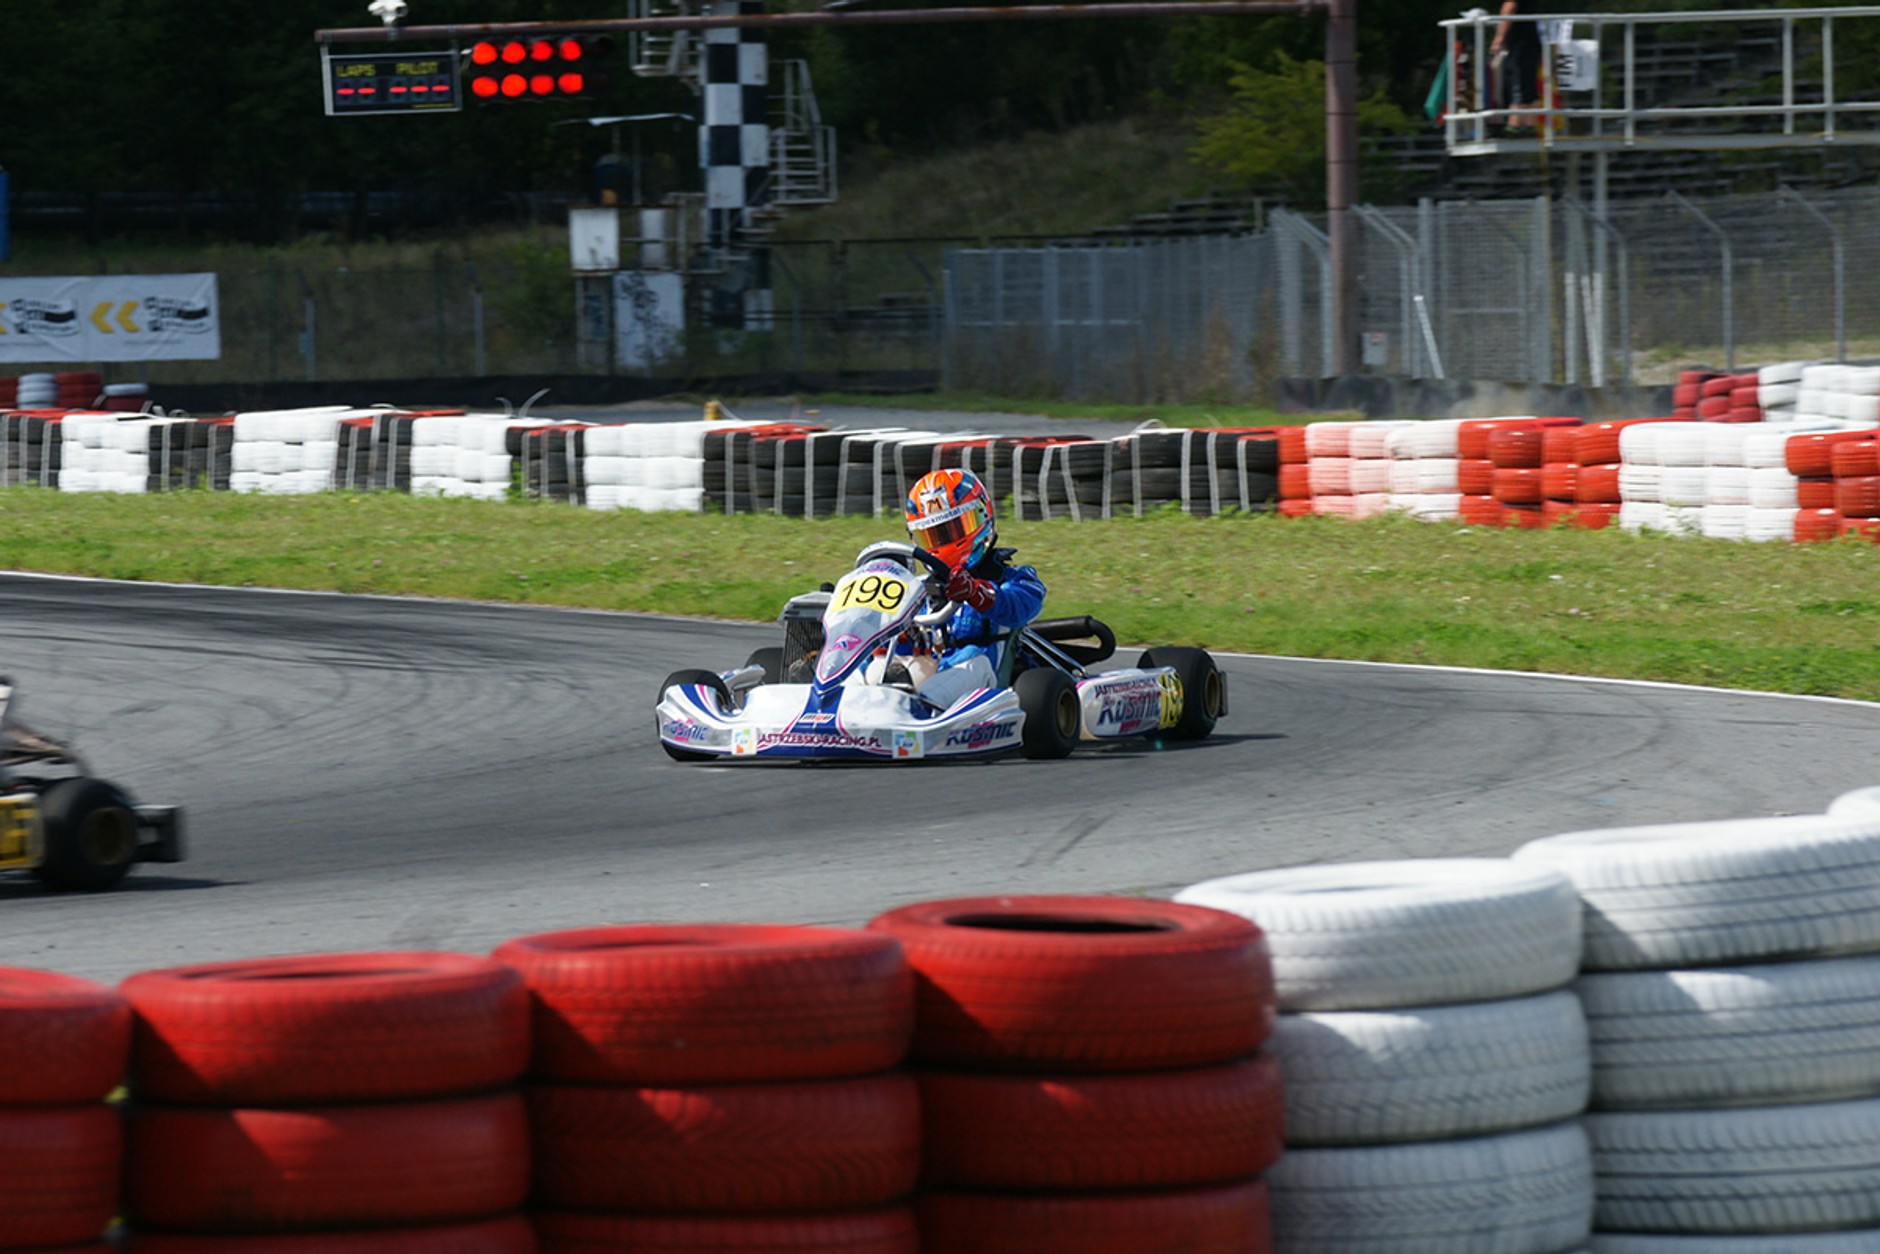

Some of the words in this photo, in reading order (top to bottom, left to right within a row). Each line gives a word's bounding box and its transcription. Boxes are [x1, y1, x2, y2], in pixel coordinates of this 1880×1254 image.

[336, 64, 376, 78] LAPS
[841, 575, 905, 610] 199
[945, 721, 1018, 747] KOSMIC
